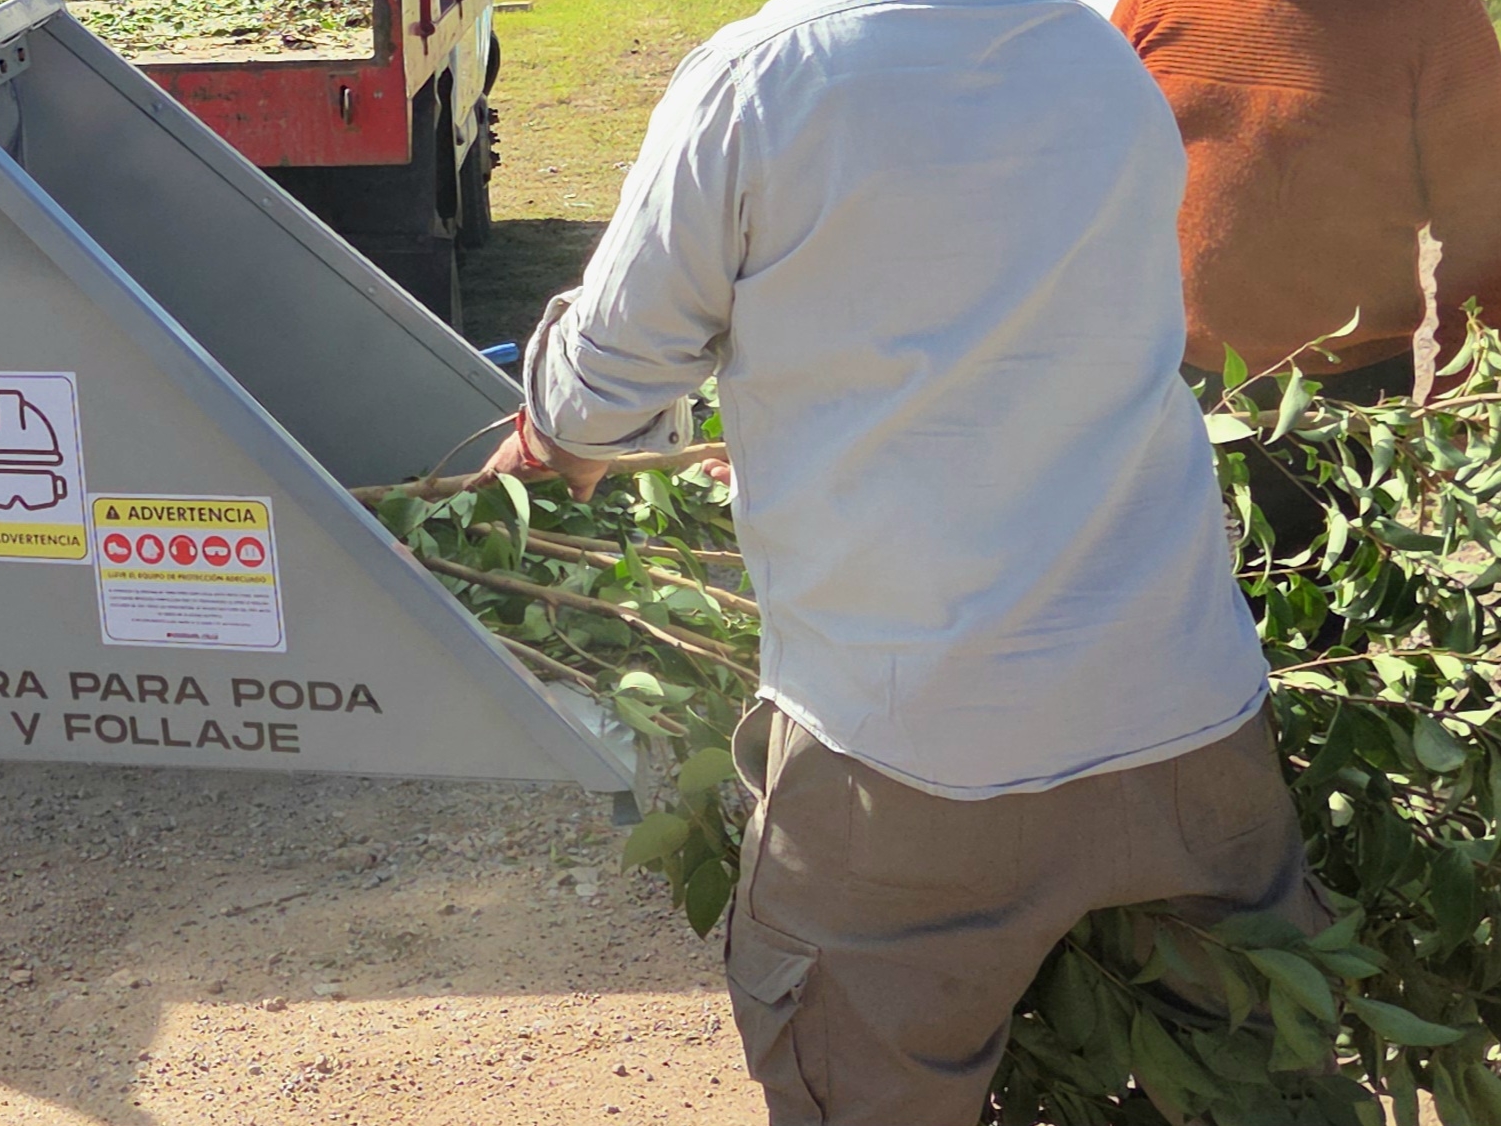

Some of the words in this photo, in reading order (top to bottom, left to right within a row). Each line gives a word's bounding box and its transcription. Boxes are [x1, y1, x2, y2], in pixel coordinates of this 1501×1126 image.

[128, 506, 256, 523] ADVERTENCIA
[69, 672, 210, 706] PARA
[231, 678, 383, 714] PODA
[11, 711, 41, 745] Y
[63, 713, 301, 753] FOLLAJE
